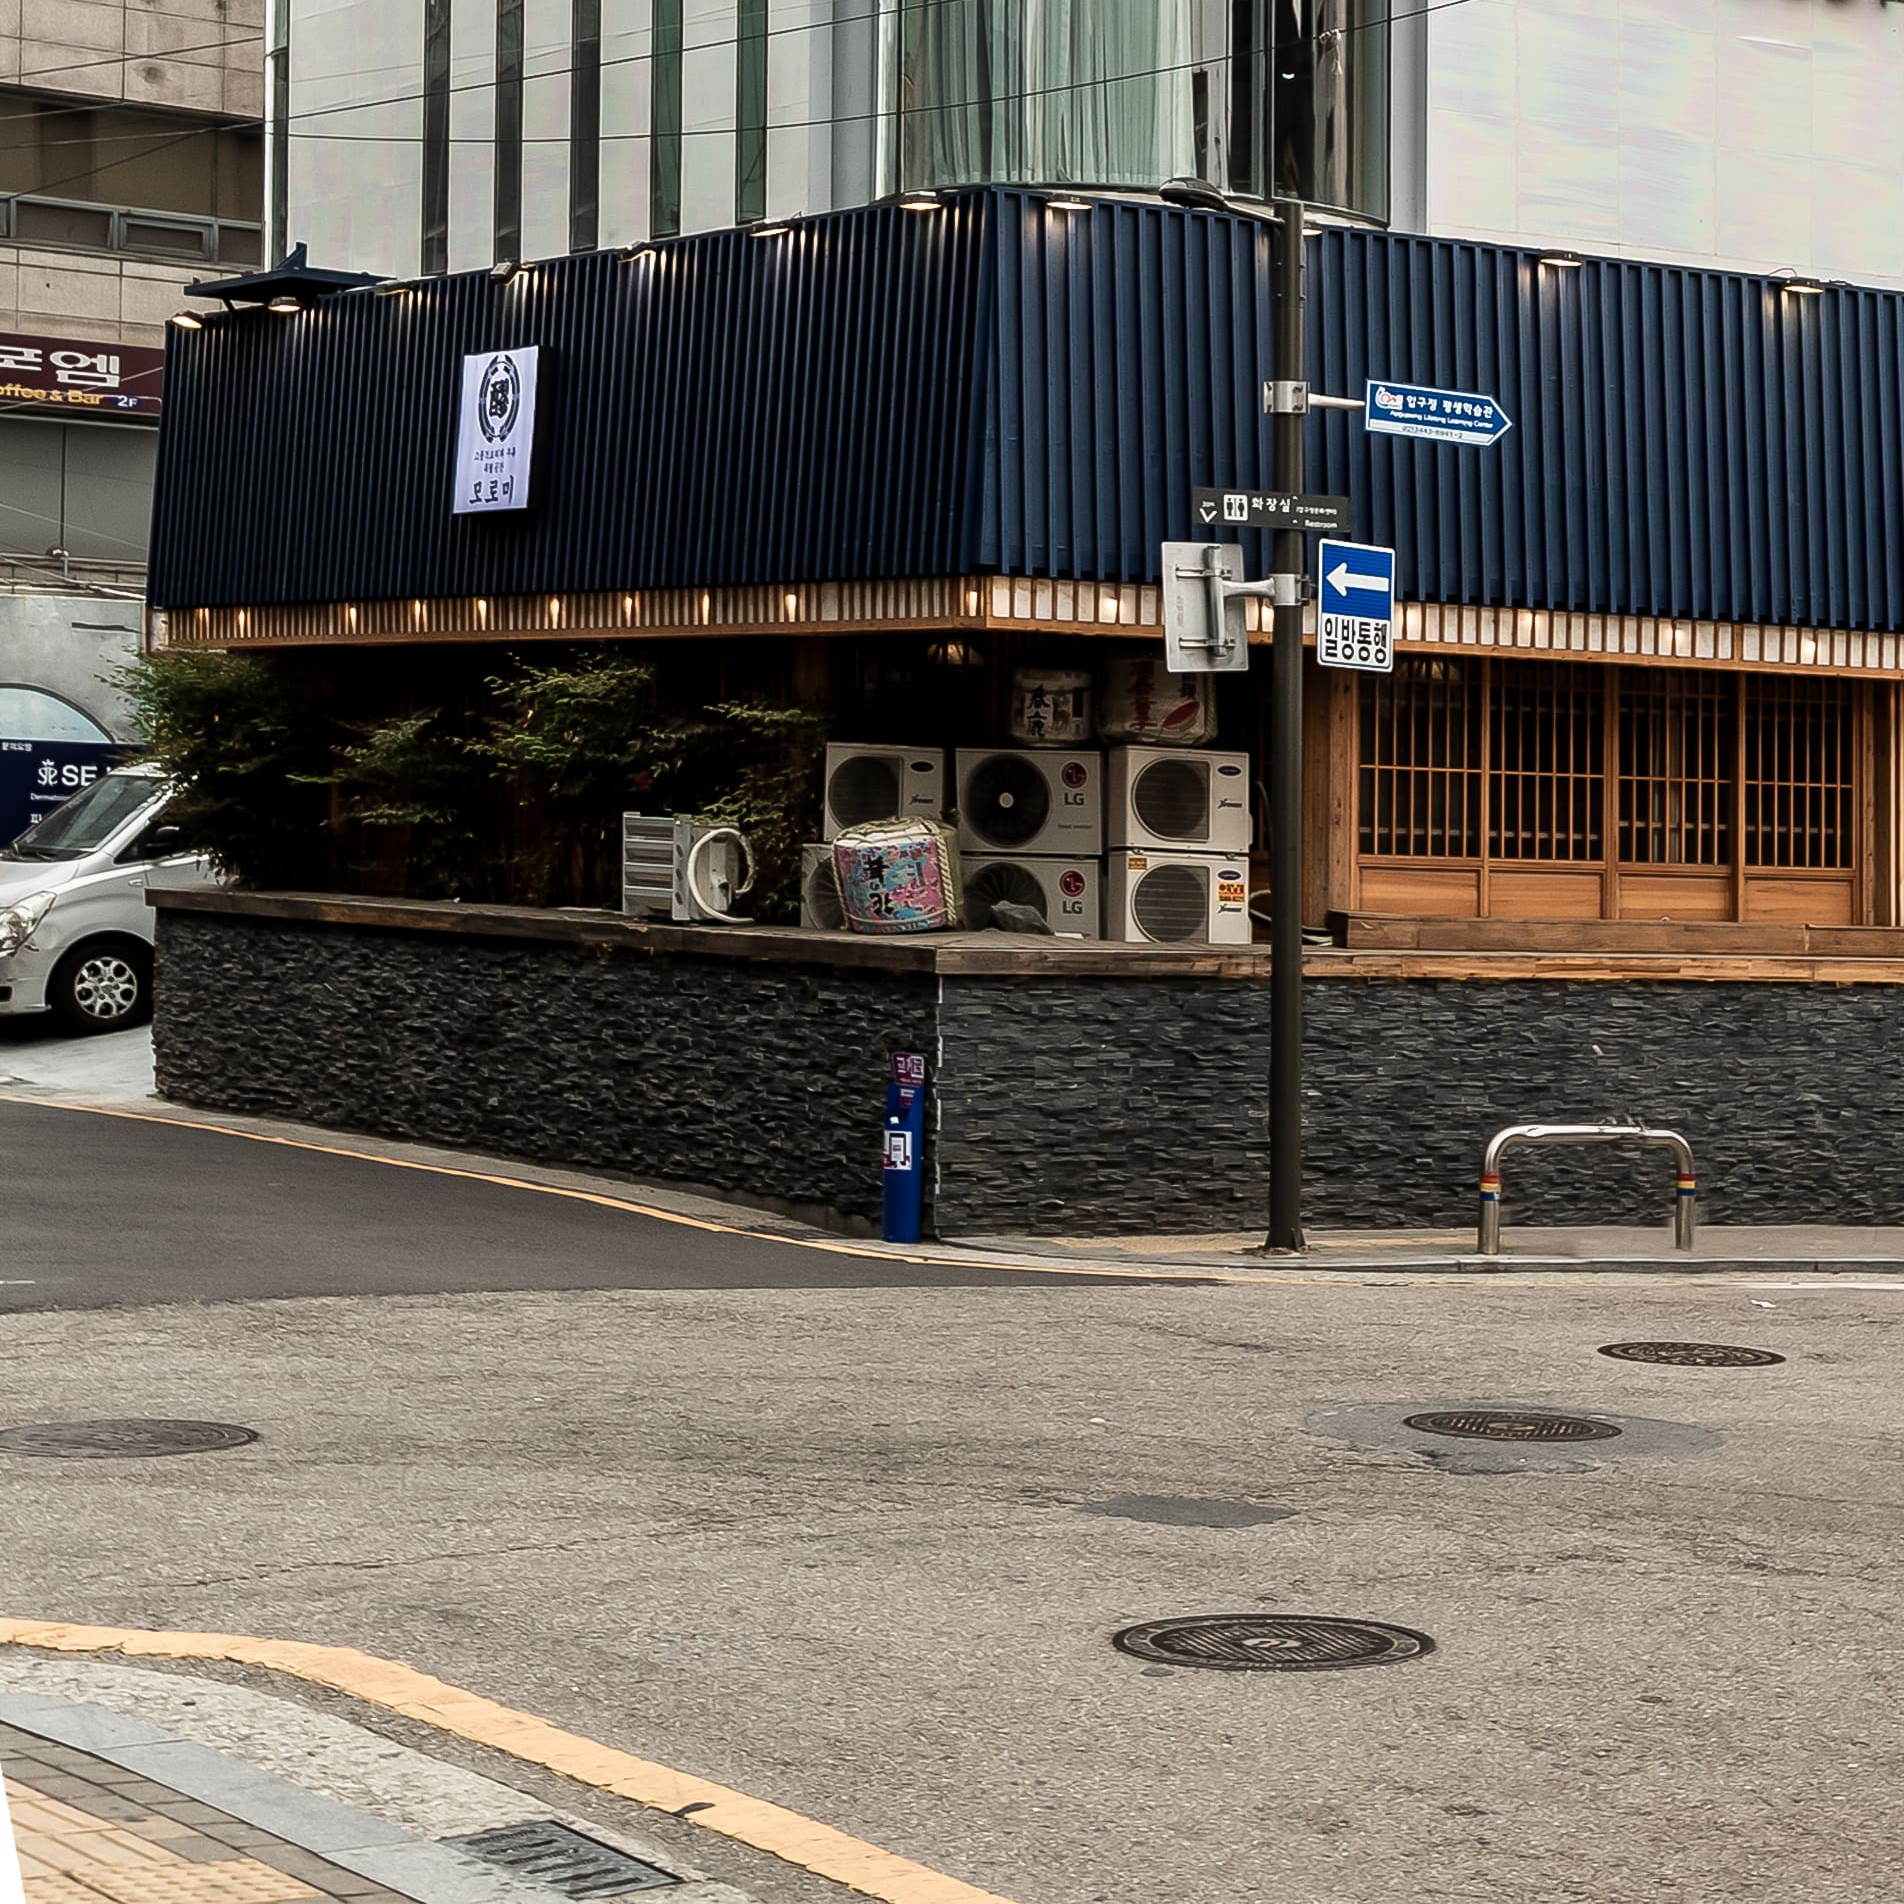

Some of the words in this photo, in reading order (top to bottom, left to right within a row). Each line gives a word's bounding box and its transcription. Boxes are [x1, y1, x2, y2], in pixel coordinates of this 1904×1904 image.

[0, 383, 46, 401] ffee
[68, 389, 100, 405] Bar
[118, 395, 138, 407] 2F
[1406, 395, 1437, 411] 압구정
[469, 475, 515, 504] 모로미
[1251, 496, 1291, 513] 화장실
[1324, 617, 1387, 664] 일방통행
[1064, 793, 1085, 806] LG
[1063, 901, 1083, 914] LG
